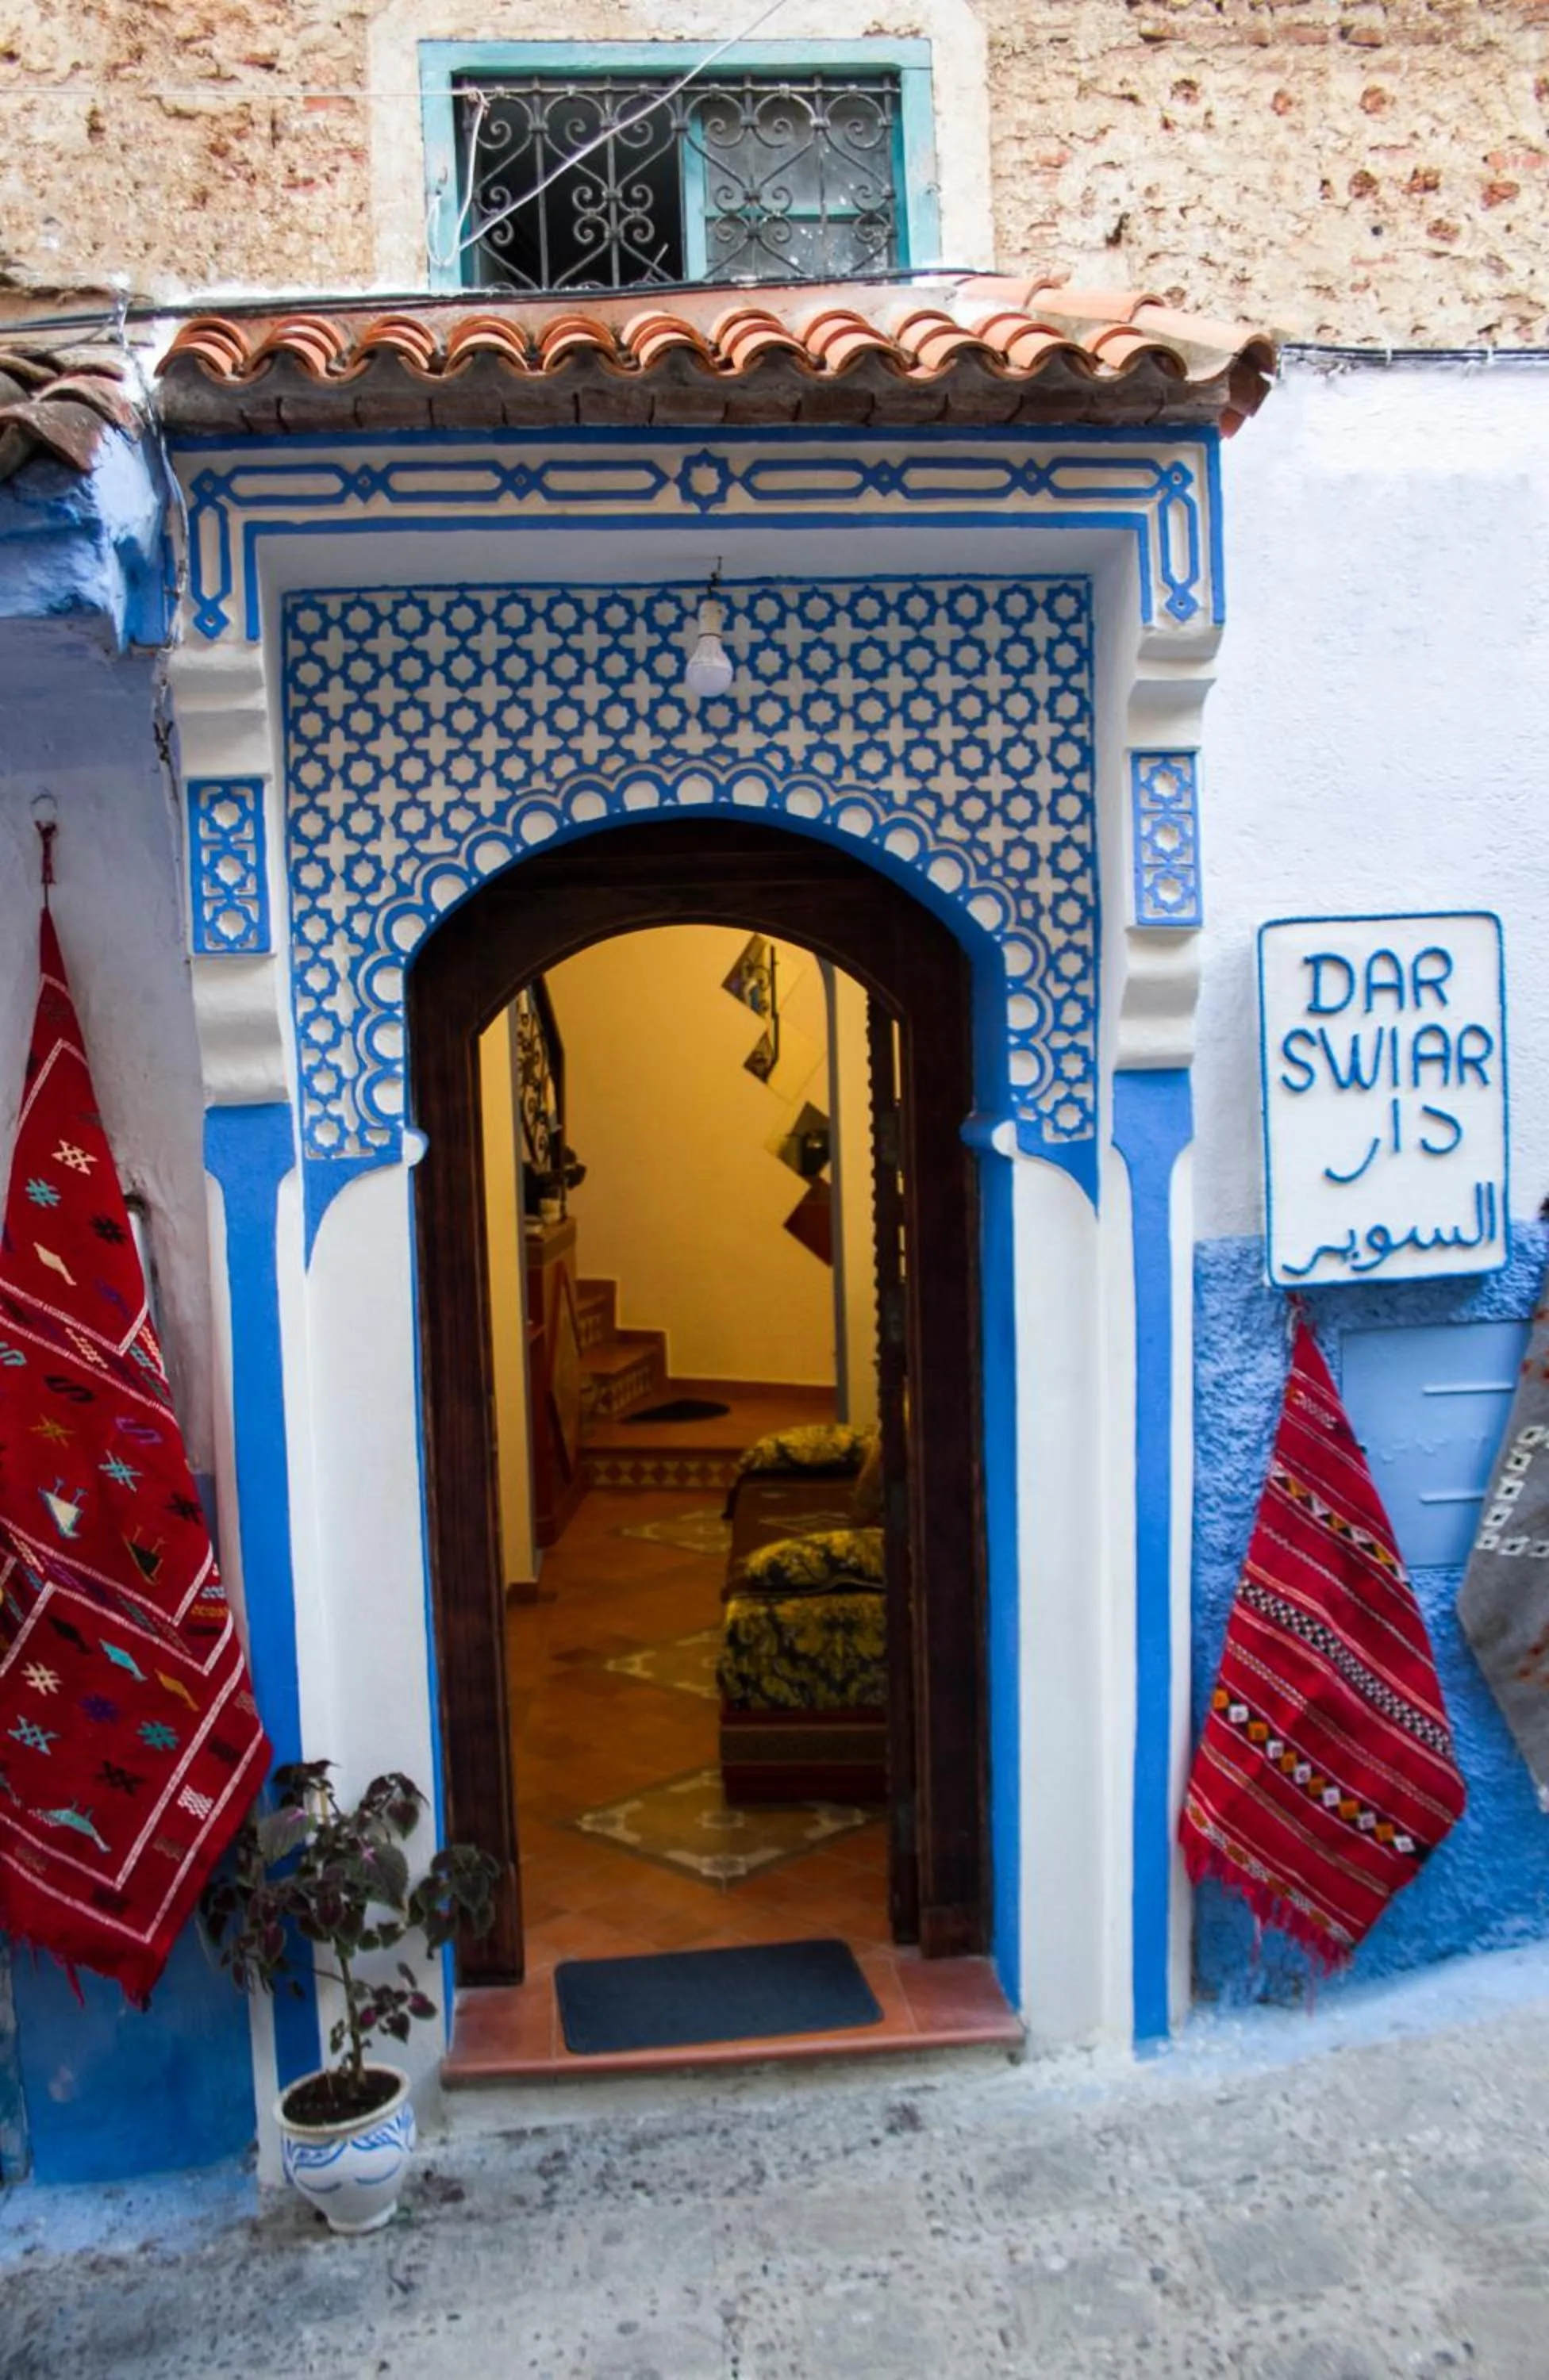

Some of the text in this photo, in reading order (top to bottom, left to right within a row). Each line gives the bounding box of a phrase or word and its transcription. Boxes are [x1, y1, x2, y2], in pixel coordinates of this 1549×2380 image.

[1303, 946, 1454, 1013] DAR
[1281, 1022, 1495, 1092] SWIAR
[1323, 1097, 1463, 1184] دار
